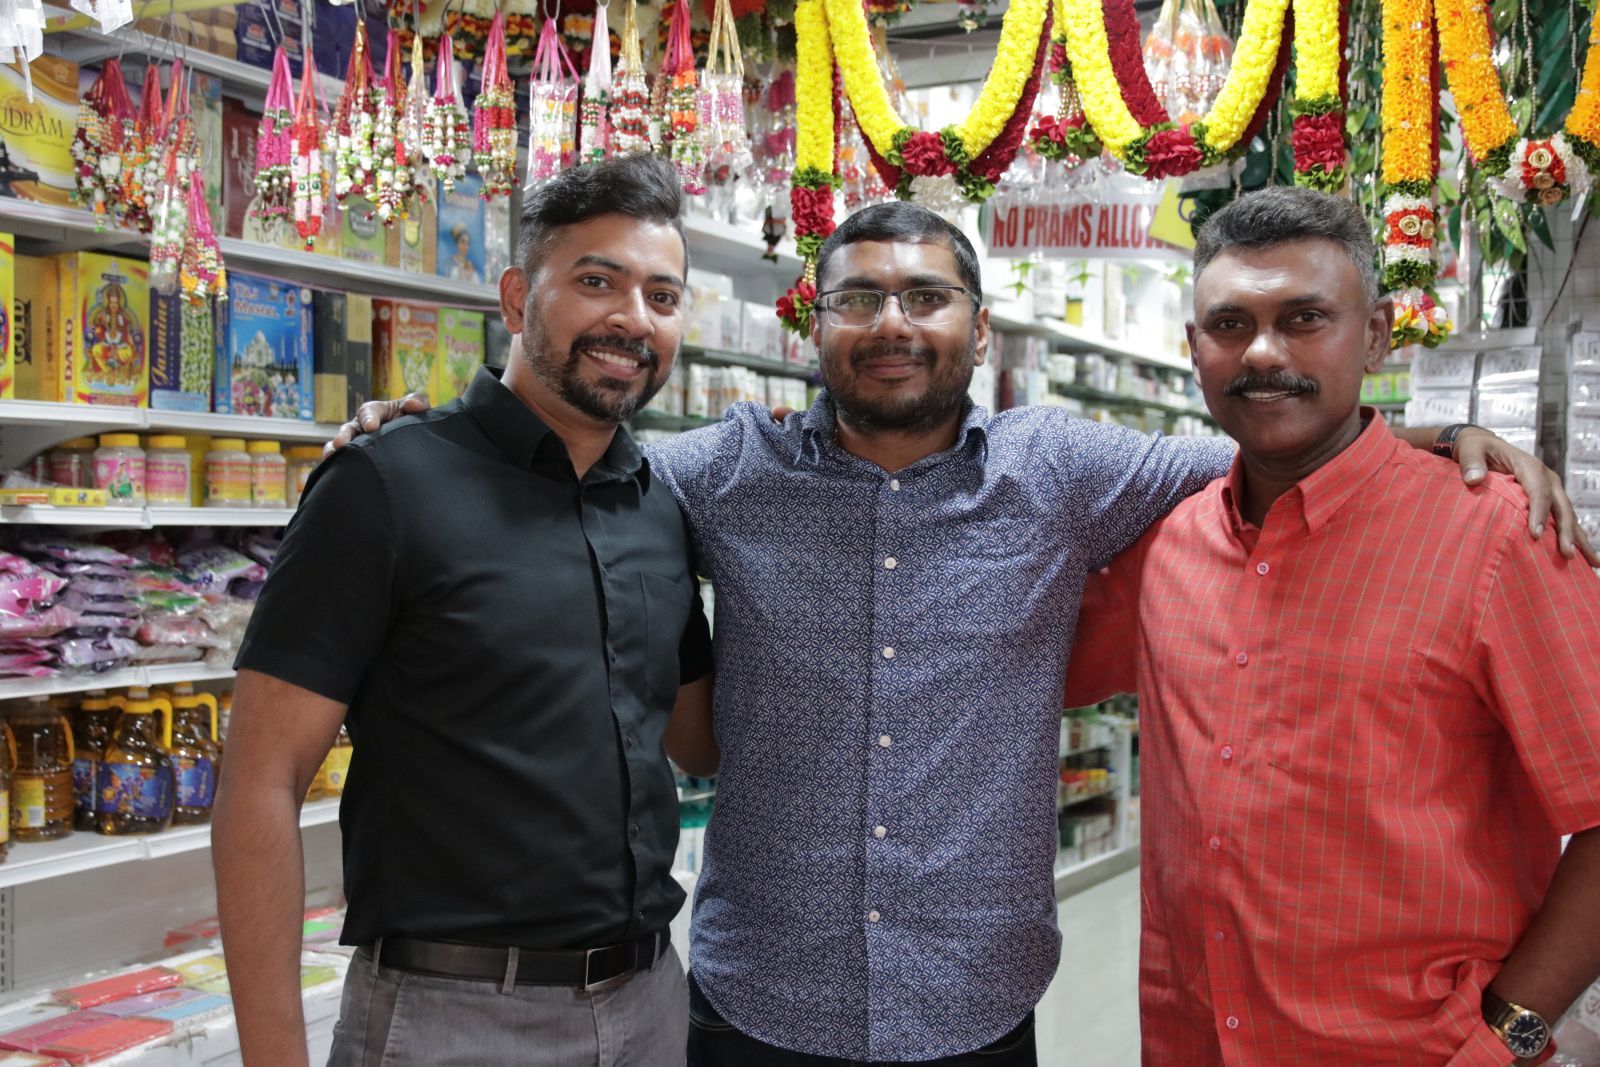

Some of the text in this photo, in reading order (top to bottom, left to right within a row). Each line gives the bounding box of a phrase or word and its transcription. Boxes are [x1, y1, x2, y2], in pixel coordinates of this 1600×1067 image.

[992, 204, 1018, 248] NO
[1022, 204, 1092, 248] PRAMS
[152, 299, 168, 386] Jasmine
